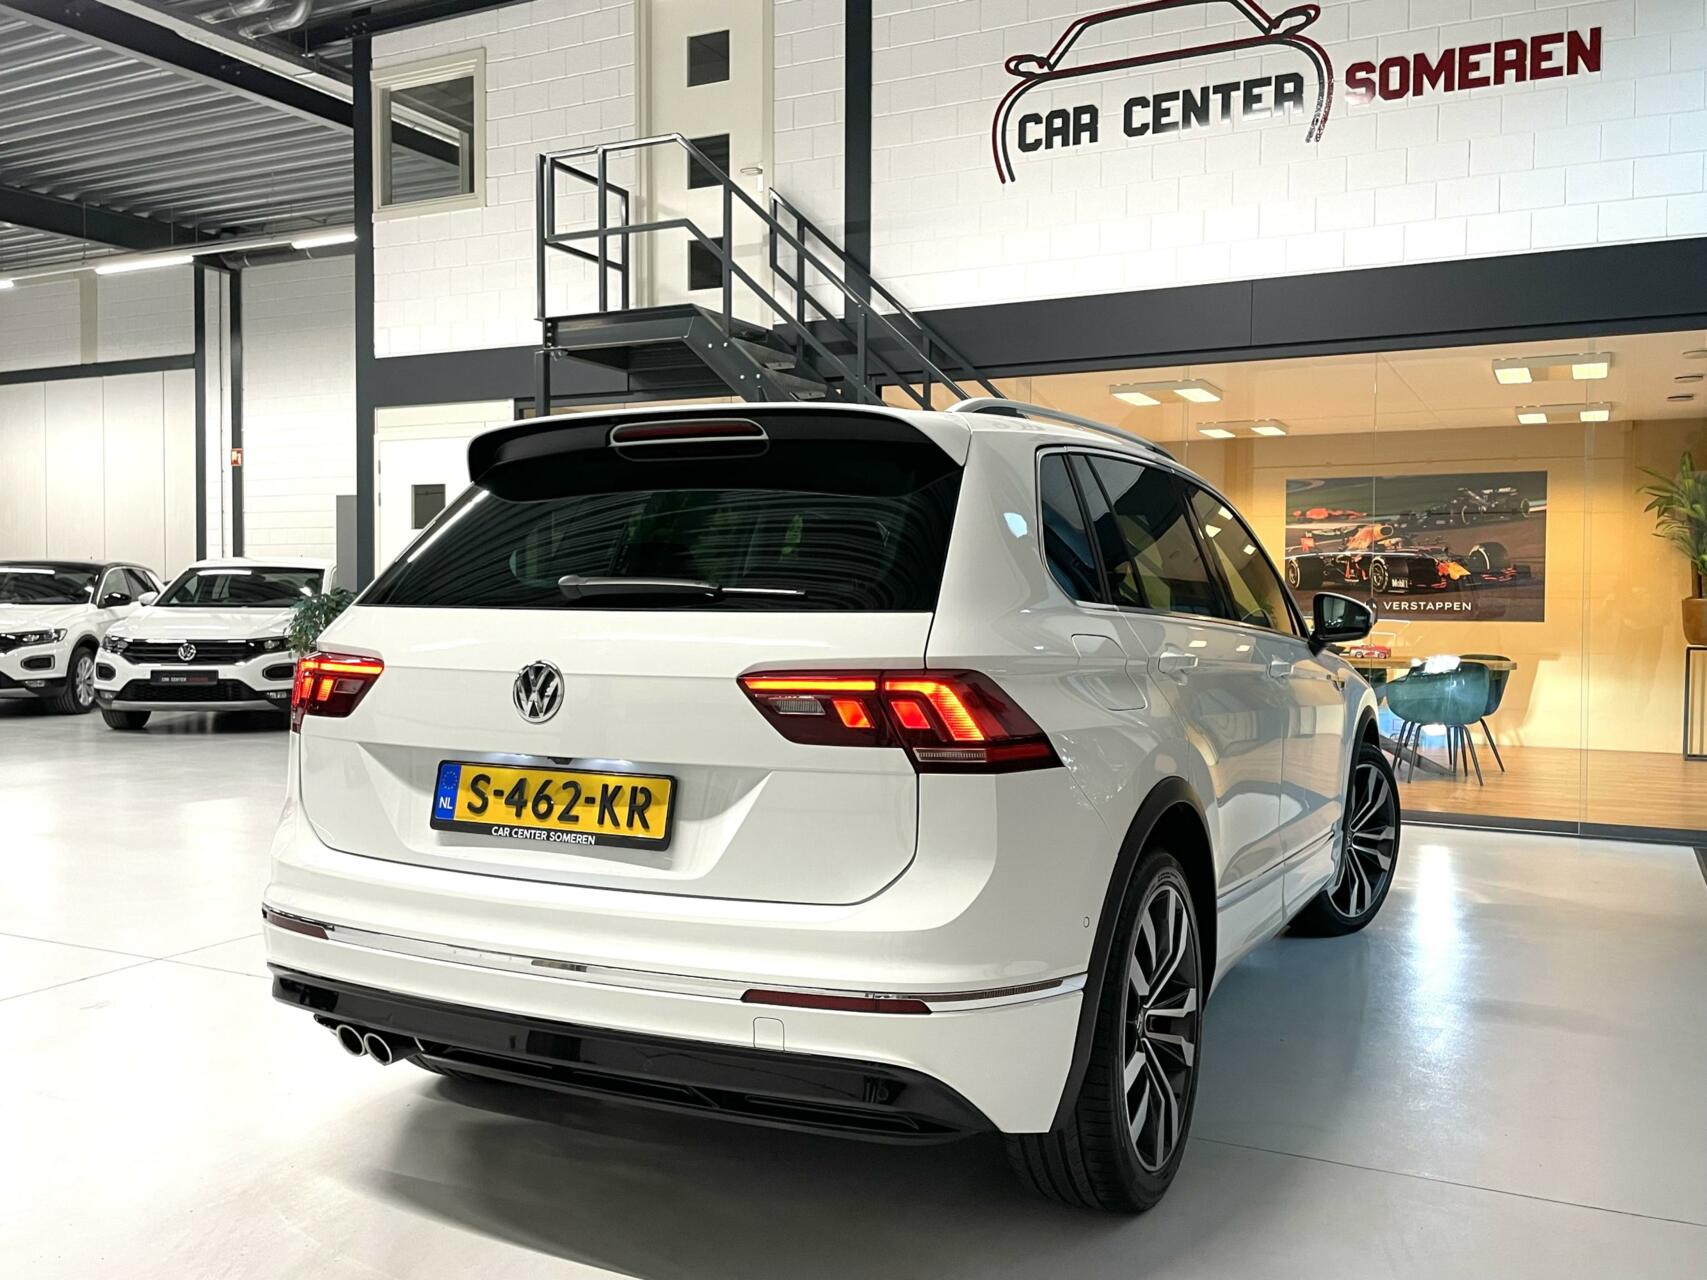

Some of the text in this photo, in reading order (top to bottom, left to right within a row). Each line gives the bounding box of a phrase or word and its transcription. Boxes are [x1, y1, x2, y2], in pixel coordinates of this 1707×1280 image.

[1018, 27, 1603, 153] CAR CENTER SOMEREN
[1383, 601, 1472, 611] VERSTAPPEN
[439, 796, 453, 810] NL
[466, 773, 653, 830] S-462-KR
[491, 826, 596, 845] CAR CENTER SOMEREN
